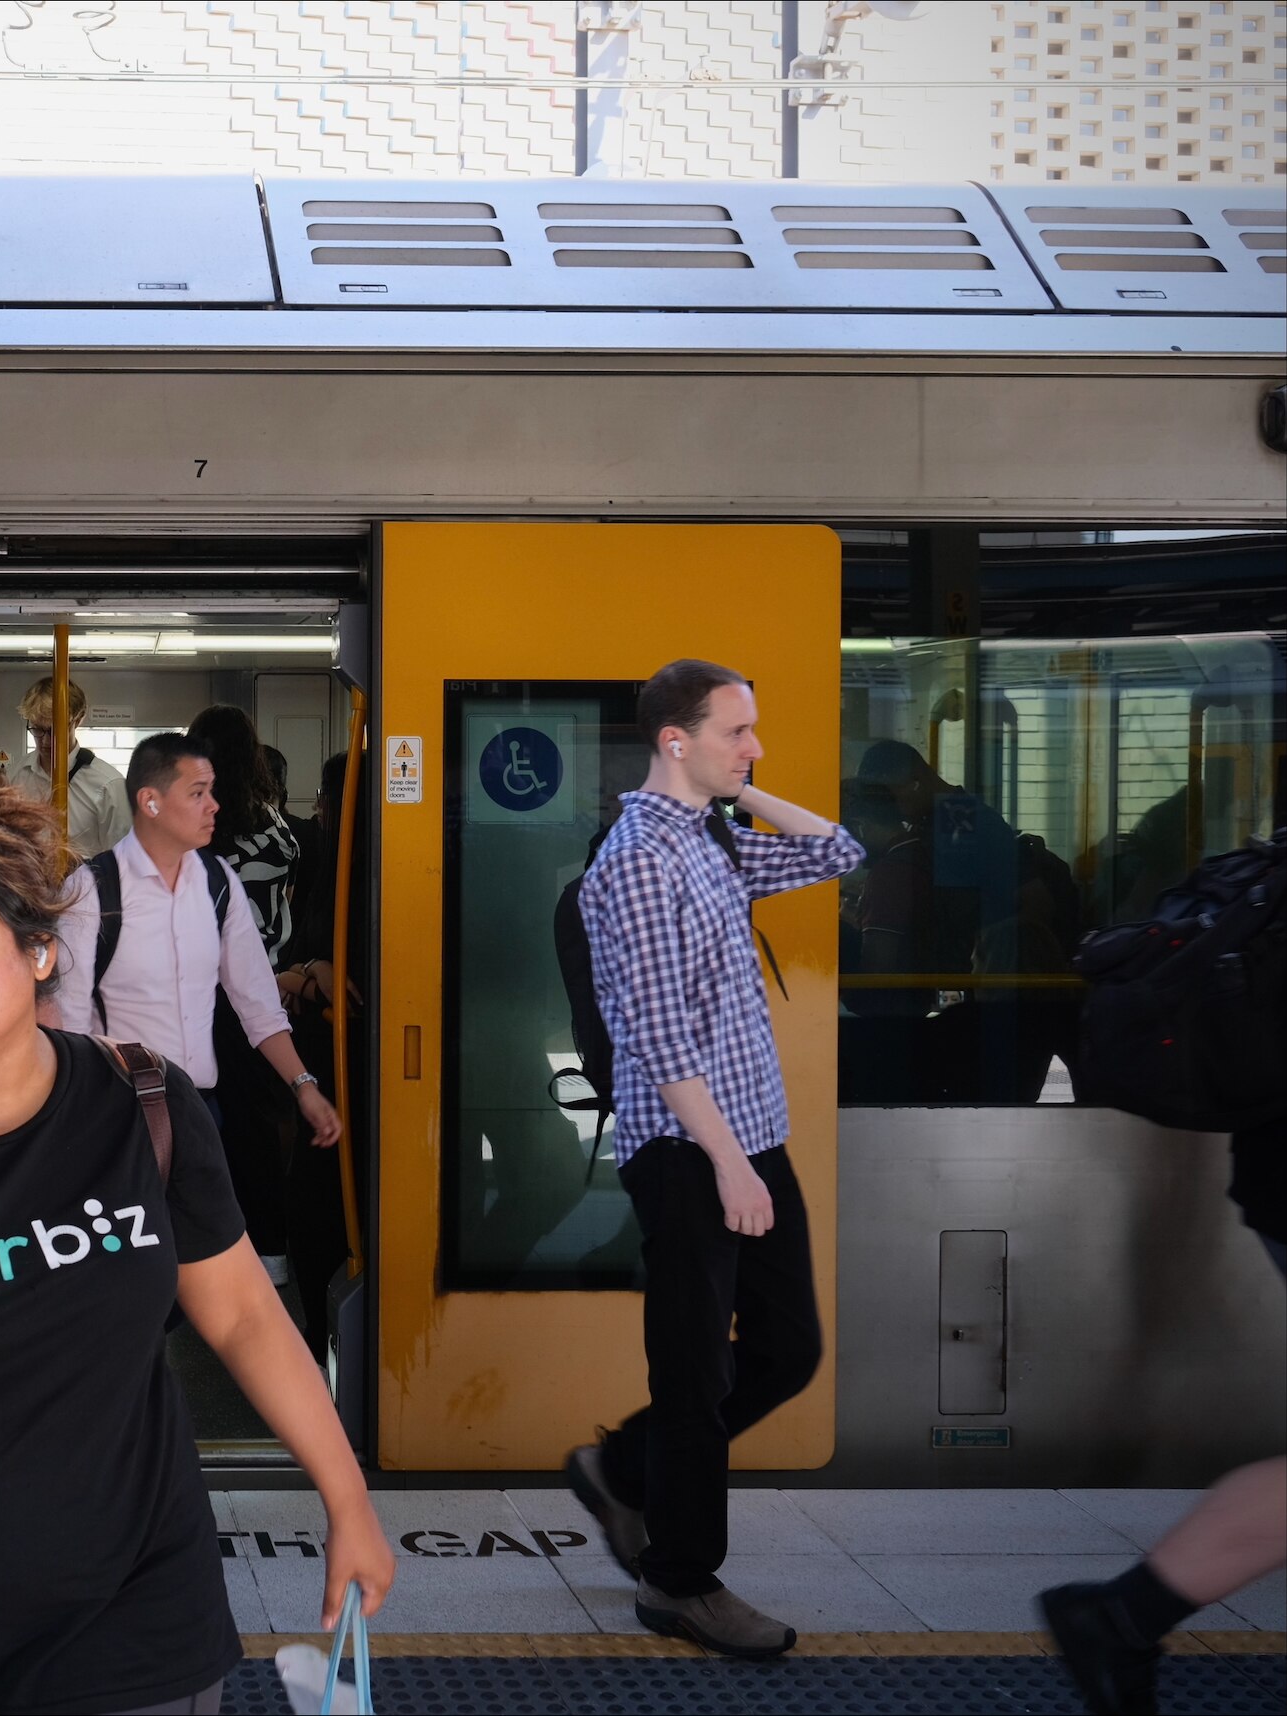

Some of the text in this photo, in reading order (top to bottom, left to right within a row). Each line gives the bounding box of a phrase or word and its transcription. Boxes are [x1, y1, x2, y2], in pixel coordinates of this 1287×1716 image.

[194, 459, 208, 478] 7
[216, 1530, 588, 1558] TH GAP
